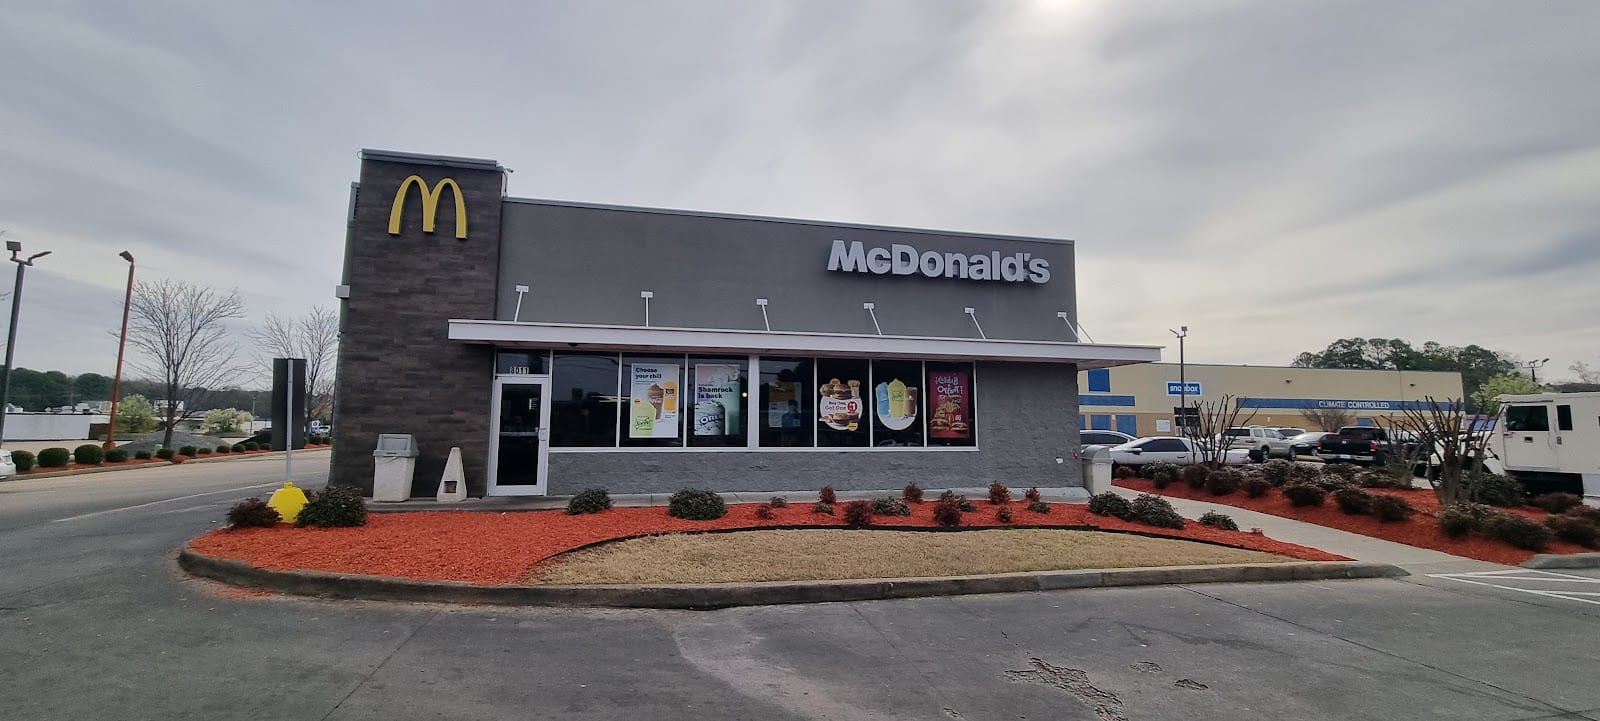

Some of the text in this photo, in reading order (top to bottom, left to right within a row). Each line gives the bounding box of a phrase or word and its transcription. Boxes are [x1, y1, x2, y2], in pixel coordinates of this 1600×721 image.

[827, 239, 1050, 284] McDonald's
[1318, 400, 1389, 409] CLIMATE CONTROLLED
